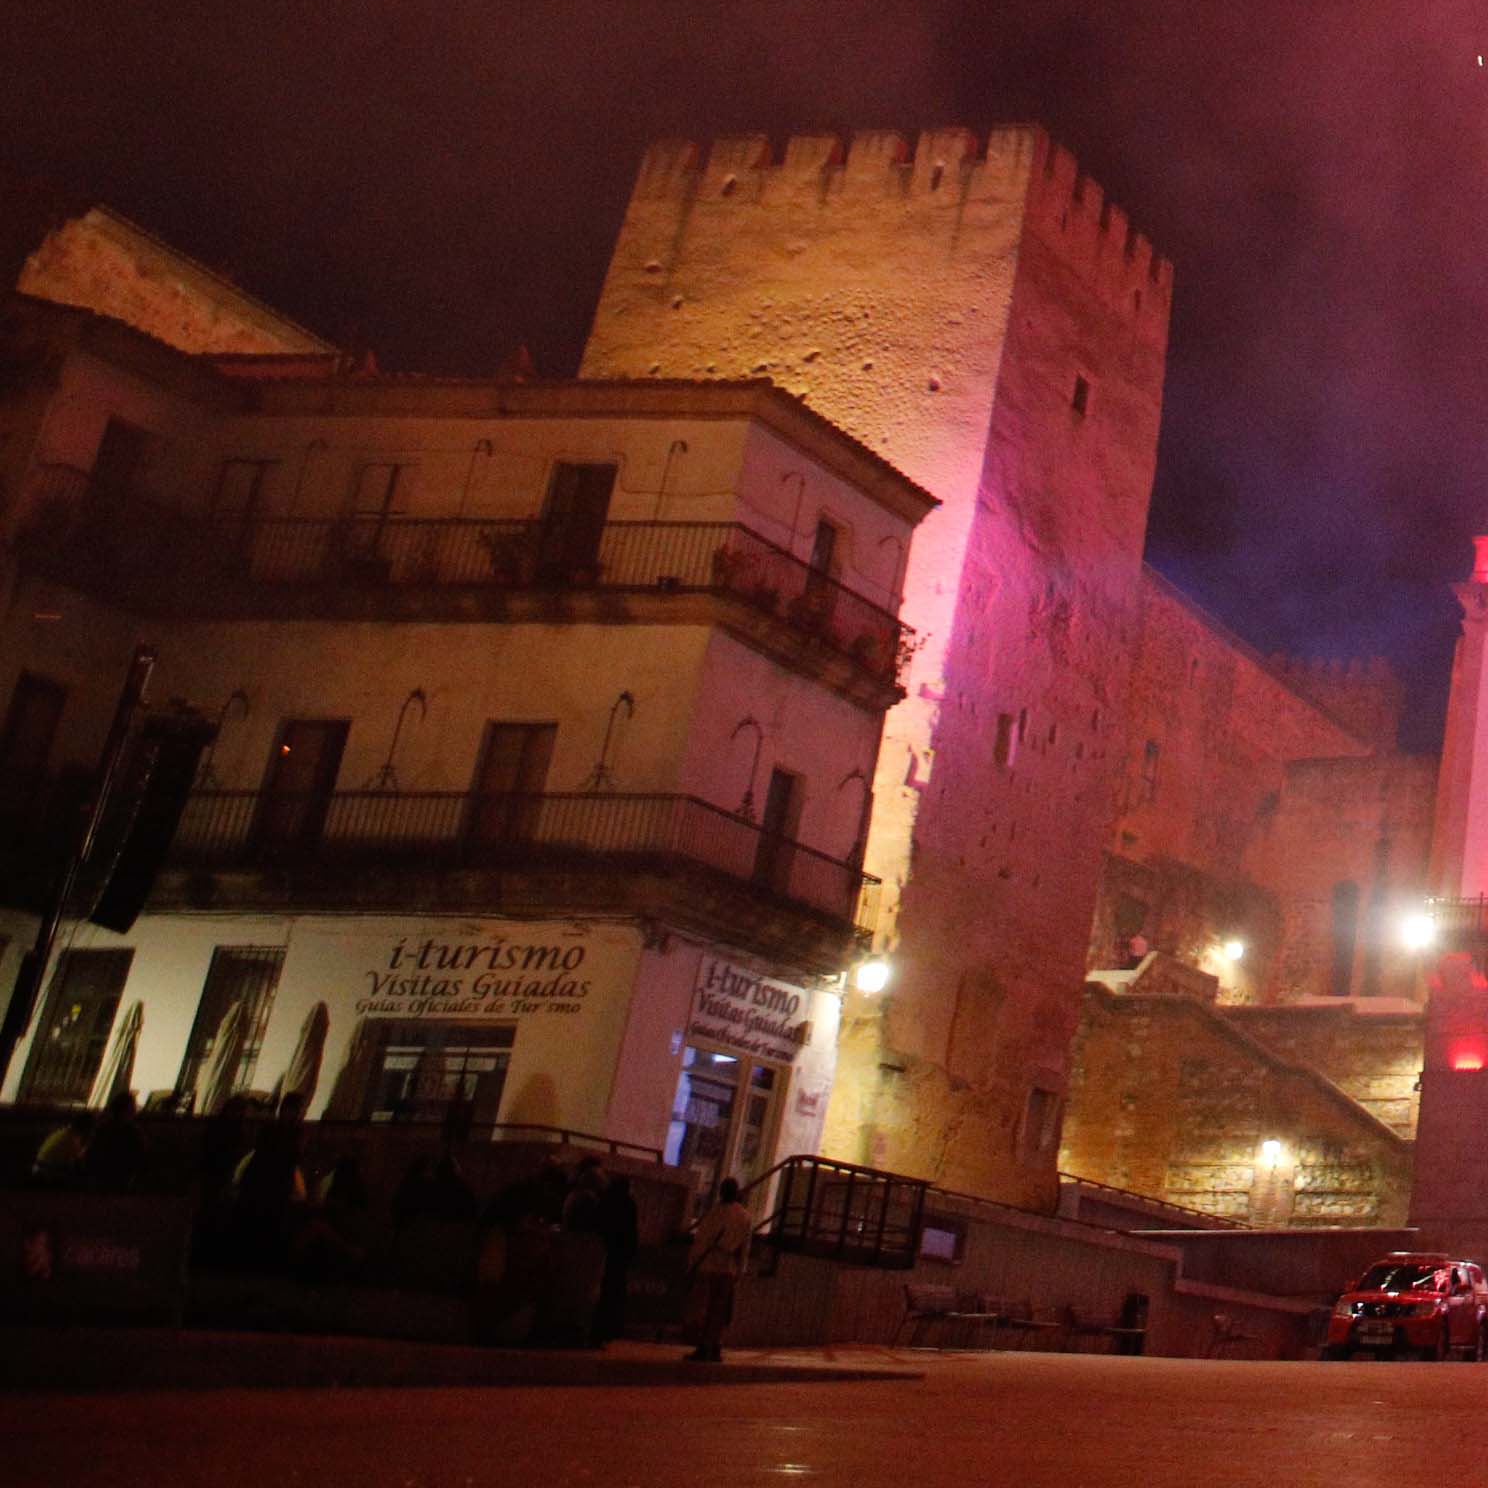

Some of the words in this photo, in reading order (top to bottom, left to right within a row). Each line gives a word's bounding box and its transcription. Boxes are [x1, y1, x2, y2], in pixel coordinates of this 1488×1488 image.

[389, 937, 585, 970] i-turismo
[366, 970, 464, 997] Visitas
[472, 971, 592, 1000] Guiadas
[484, 999, 505, 1013] de
[511, 1000, 582, 1015] Tursmo
